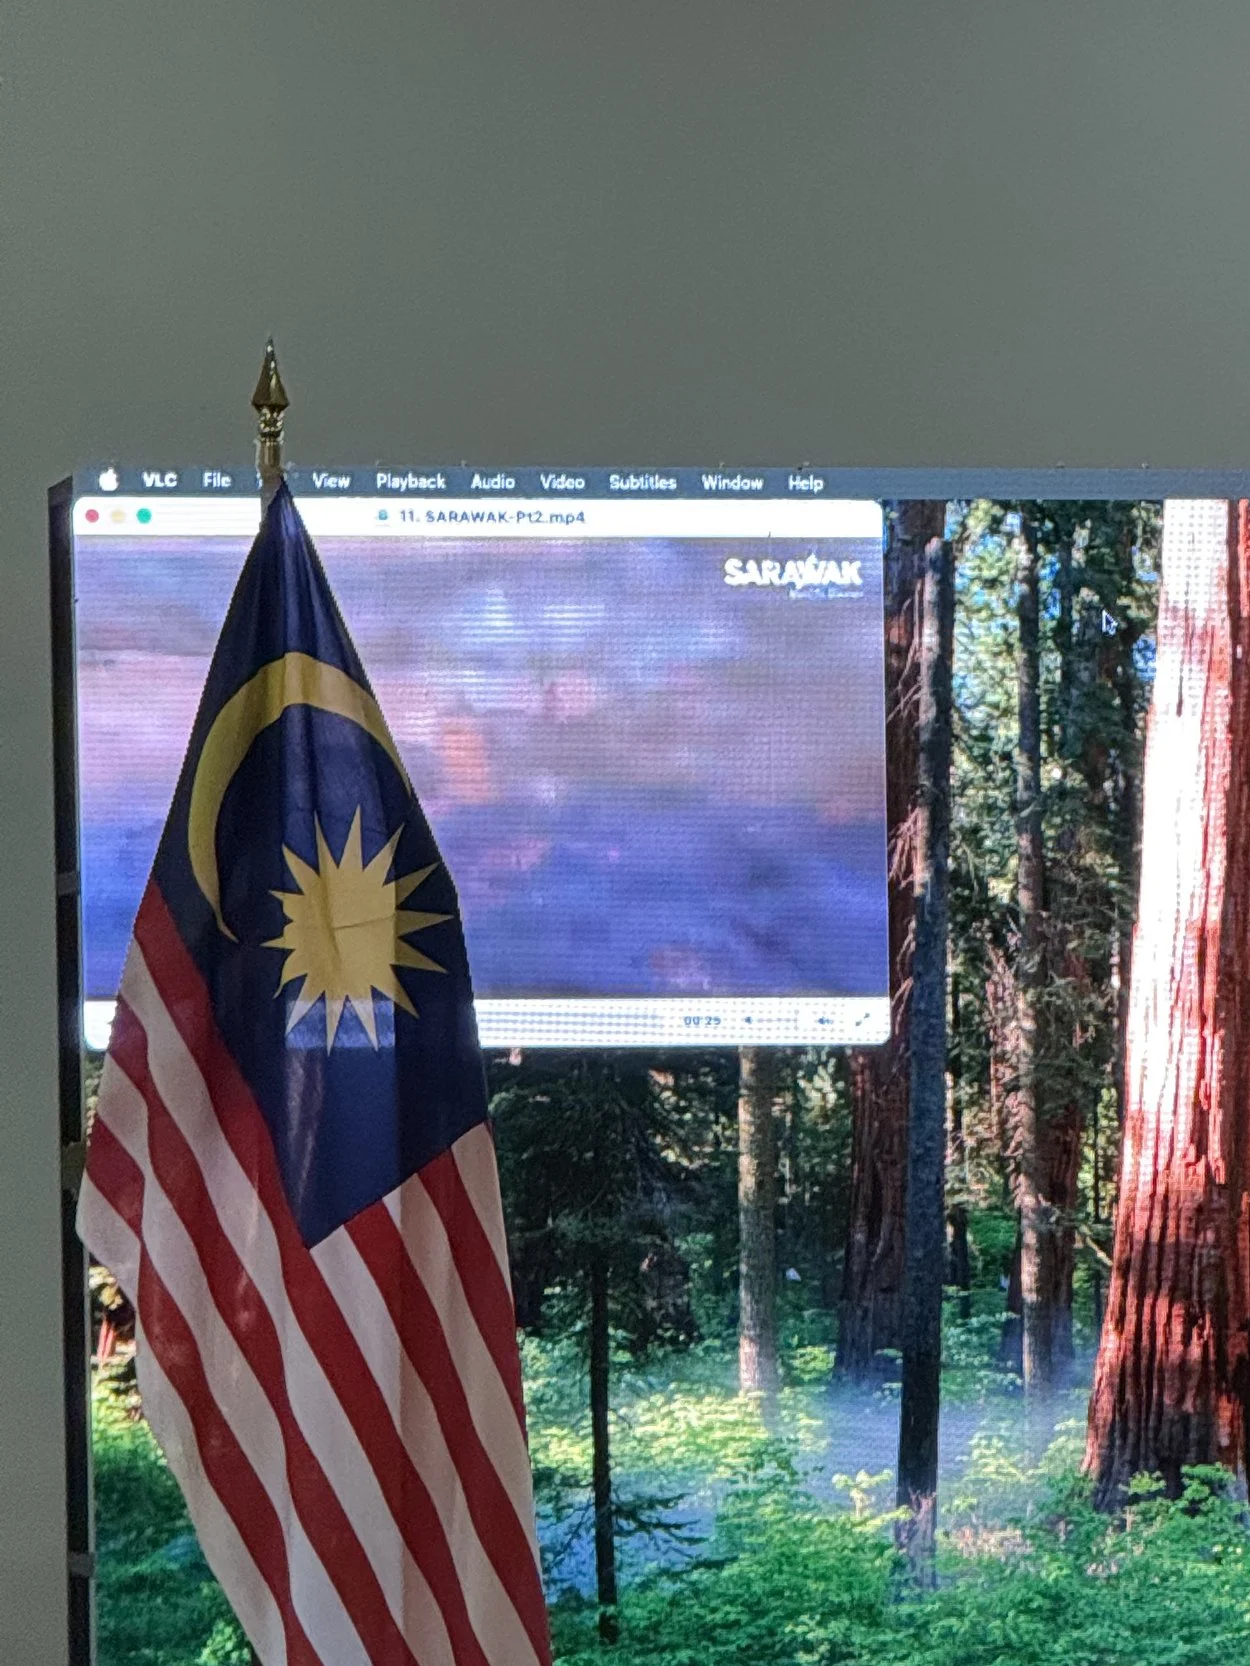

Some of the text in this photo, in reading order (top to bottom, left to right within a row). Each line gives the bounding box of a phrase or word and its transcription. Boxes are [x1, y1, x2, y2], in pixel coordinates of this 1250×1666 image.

[142, 471, 824, 493] VLC File View Playback Audio Video Subtitles Window Help
[400, 510, 586, 525] 11. SARAWAK-Pt2.mp4
[724, 553, 863, 588] SARAWAK
